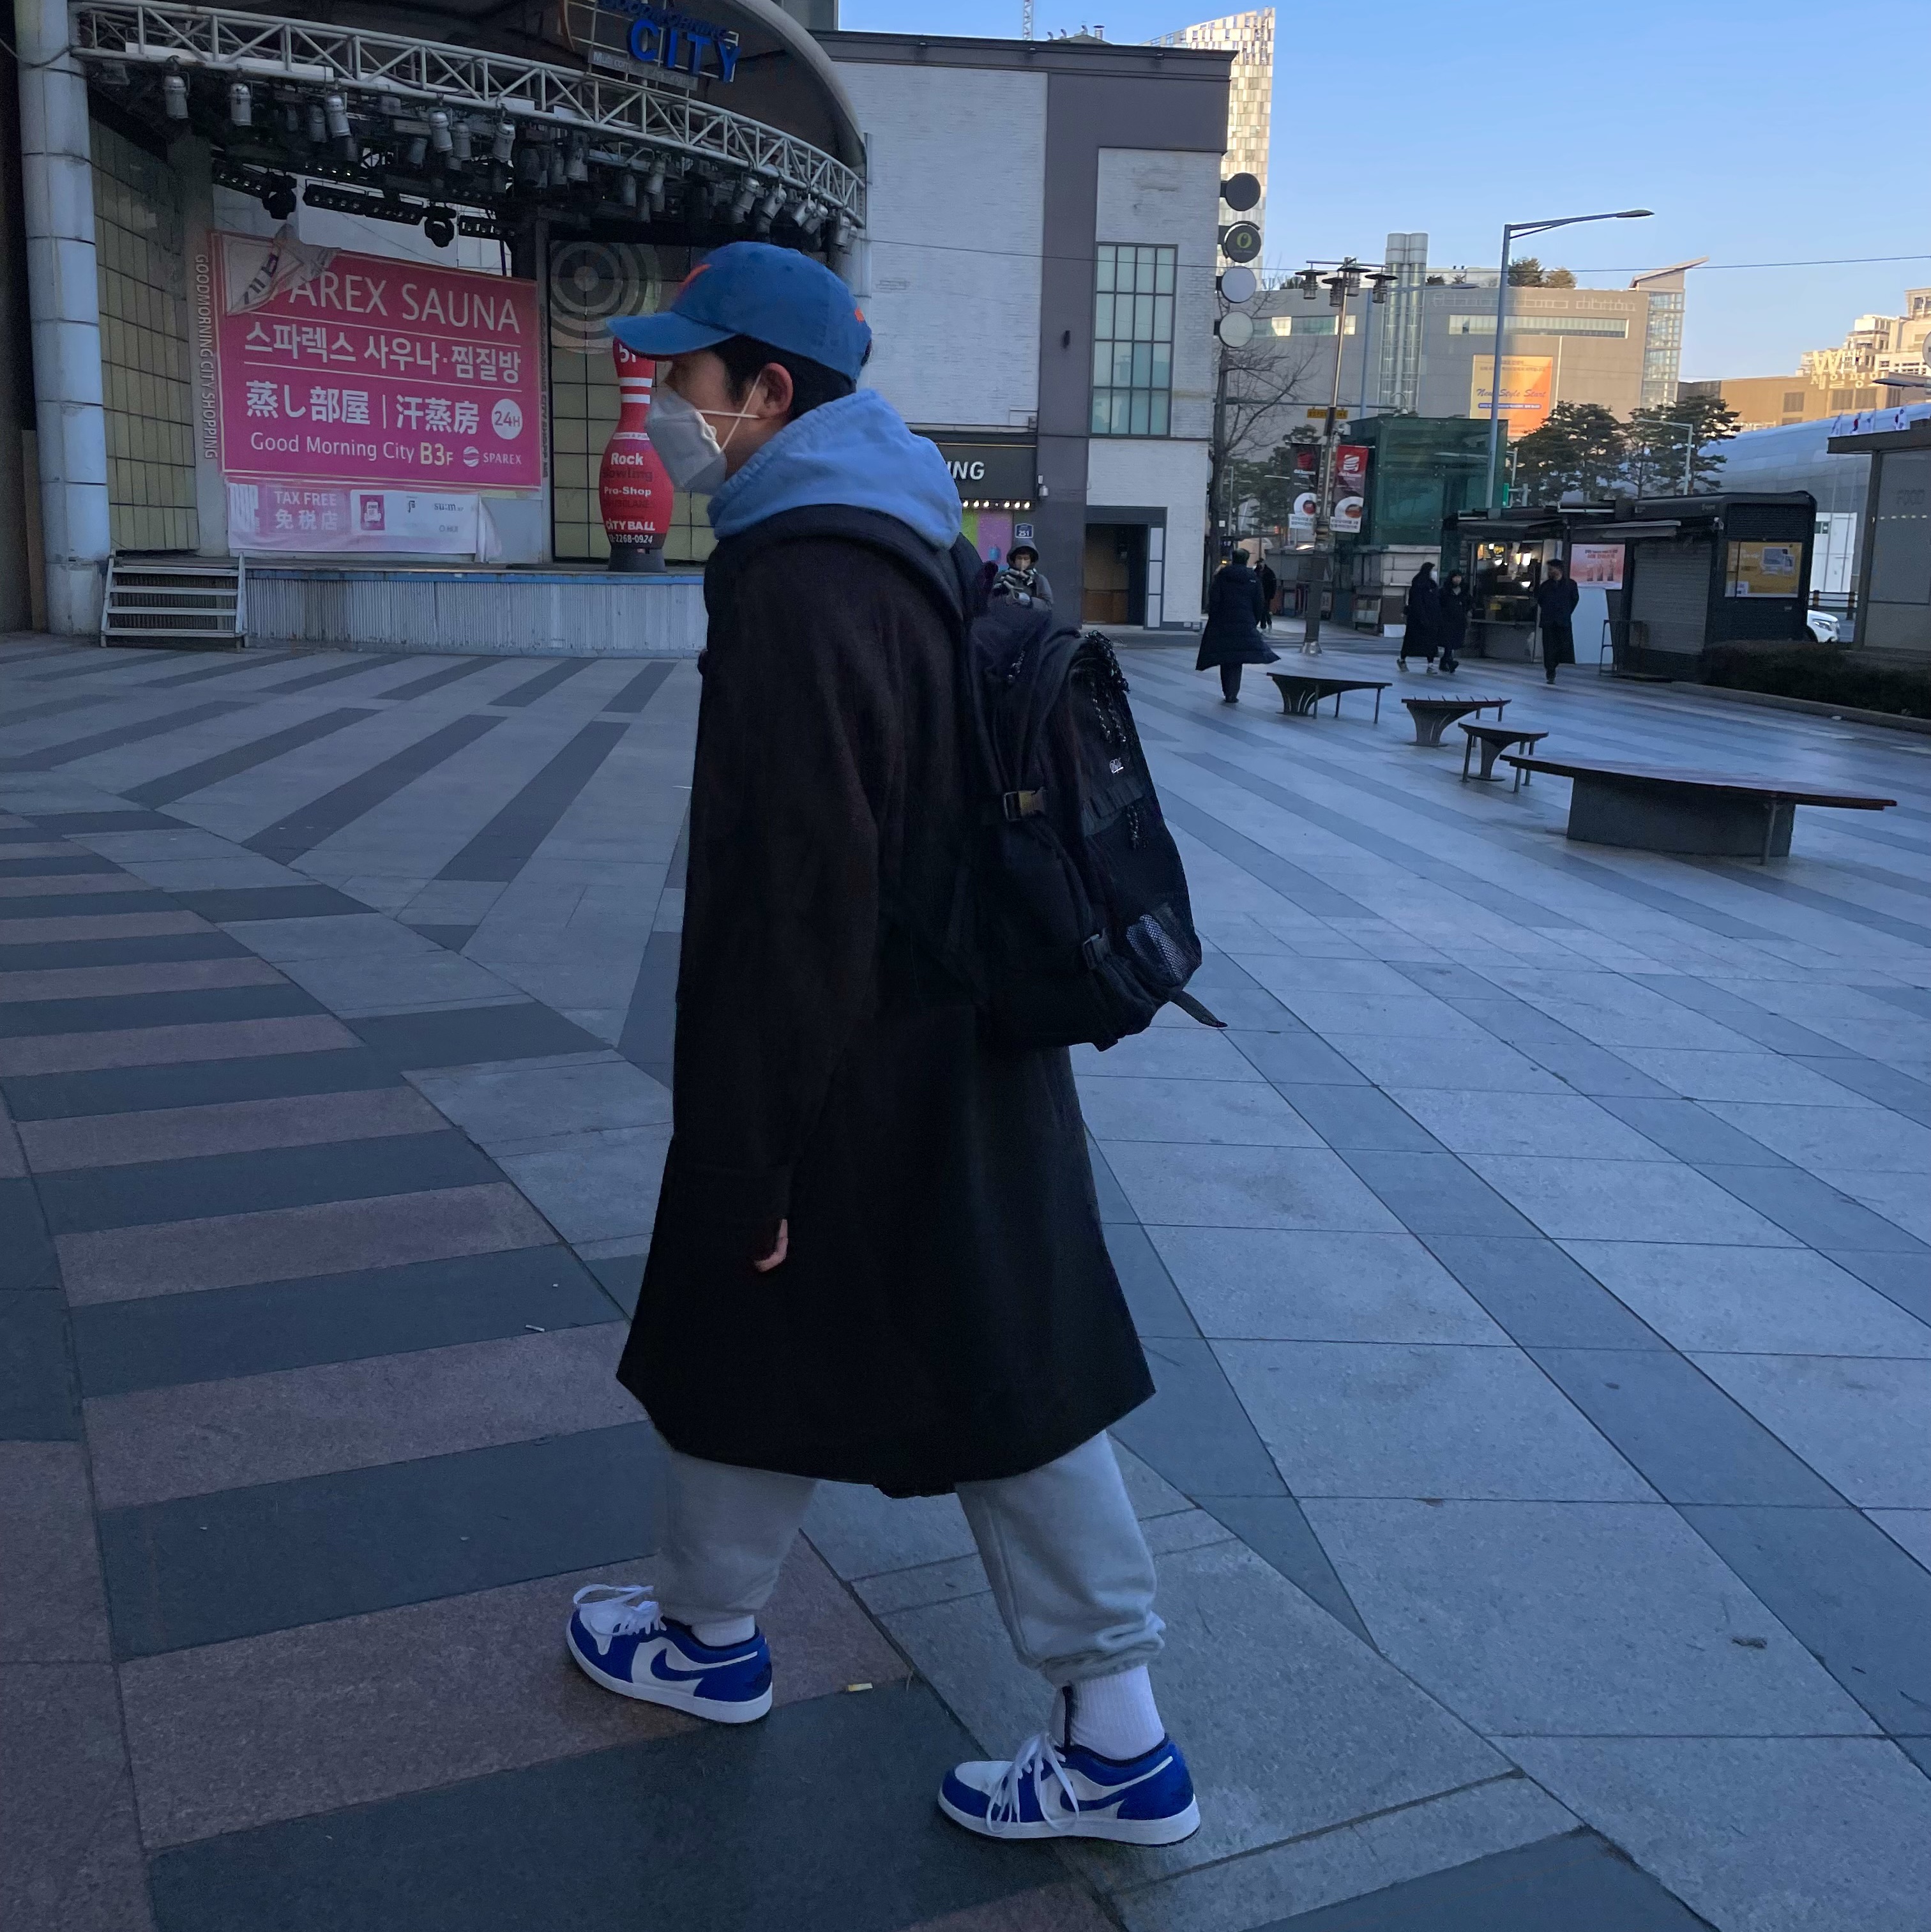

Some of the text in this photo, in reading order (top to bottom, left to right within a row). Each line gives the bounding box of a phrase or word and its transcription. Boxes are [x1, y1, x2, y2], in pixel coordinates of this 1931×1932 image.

[627, 19, 741, 83] CITY
[402, 283, 521, 335] SAUNA
[245, 321, 356, 363] 스파렉스
[195, 255, 218, 459] GOODMORNING CITY SHOPPING
[1499, 389, 1520, 397] Style
[246, 380, 480, 435] 蒸し部屋 汗蒸房
[494, 410, 521, 428] 24H
[251, 432, 453, 466] Good Morning City B3F
[483, 452, 522, 466] SPAREX
[611, 452, 644, 466] Rock
[274, 491, 337, 506] TAX FREE
[604, 486, 651, 498] Pro-Shop
[627, 521, 655, 531] BALL
